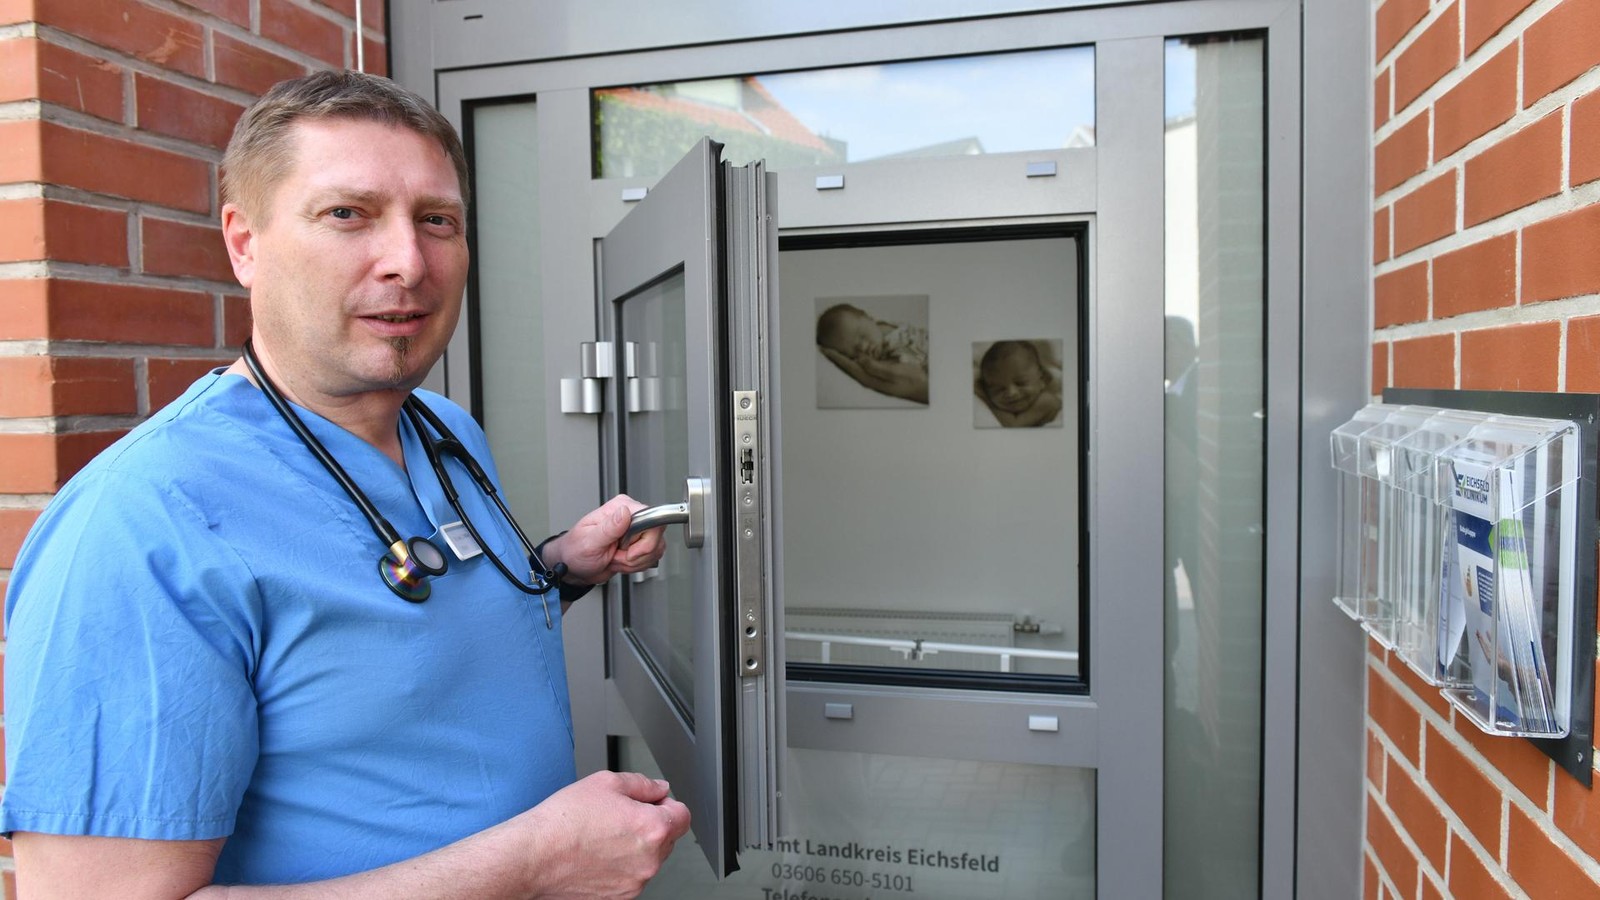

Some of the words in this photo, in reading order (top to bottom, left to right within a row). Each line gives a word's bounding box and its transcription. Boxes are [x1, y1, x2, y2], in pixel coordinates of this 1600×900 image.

[806, 839, 902, 864] Landkreis
[907, 848, 999, 873] Eichsfeld
[771, 862, 826, 883] 03606
[831, 868, 915, 892] 650-5101
